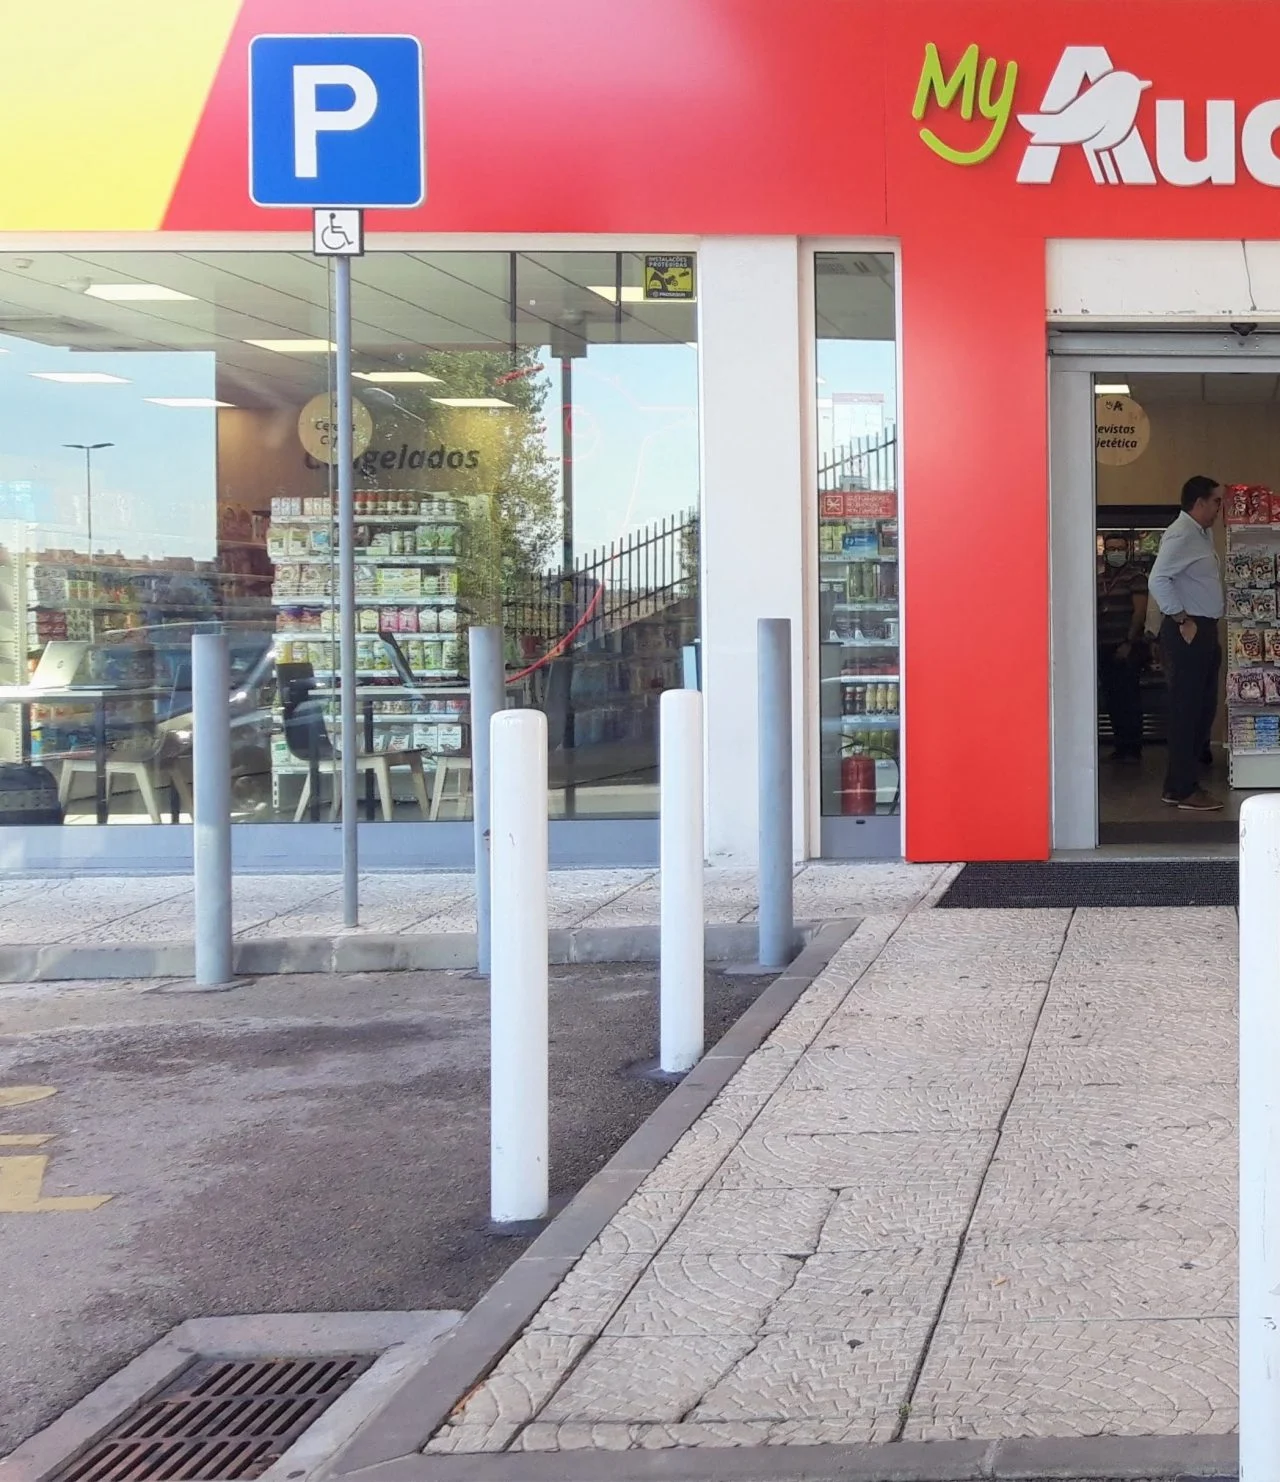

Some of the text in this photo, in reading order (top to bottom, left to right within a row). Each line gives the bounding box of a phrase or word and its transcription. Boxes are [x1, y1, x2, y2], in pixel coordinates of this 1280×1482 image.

[293, 65, 378, 178] P
[912, 42, 1018, 165] My
[1096, 424, 1136, 434] evistas
